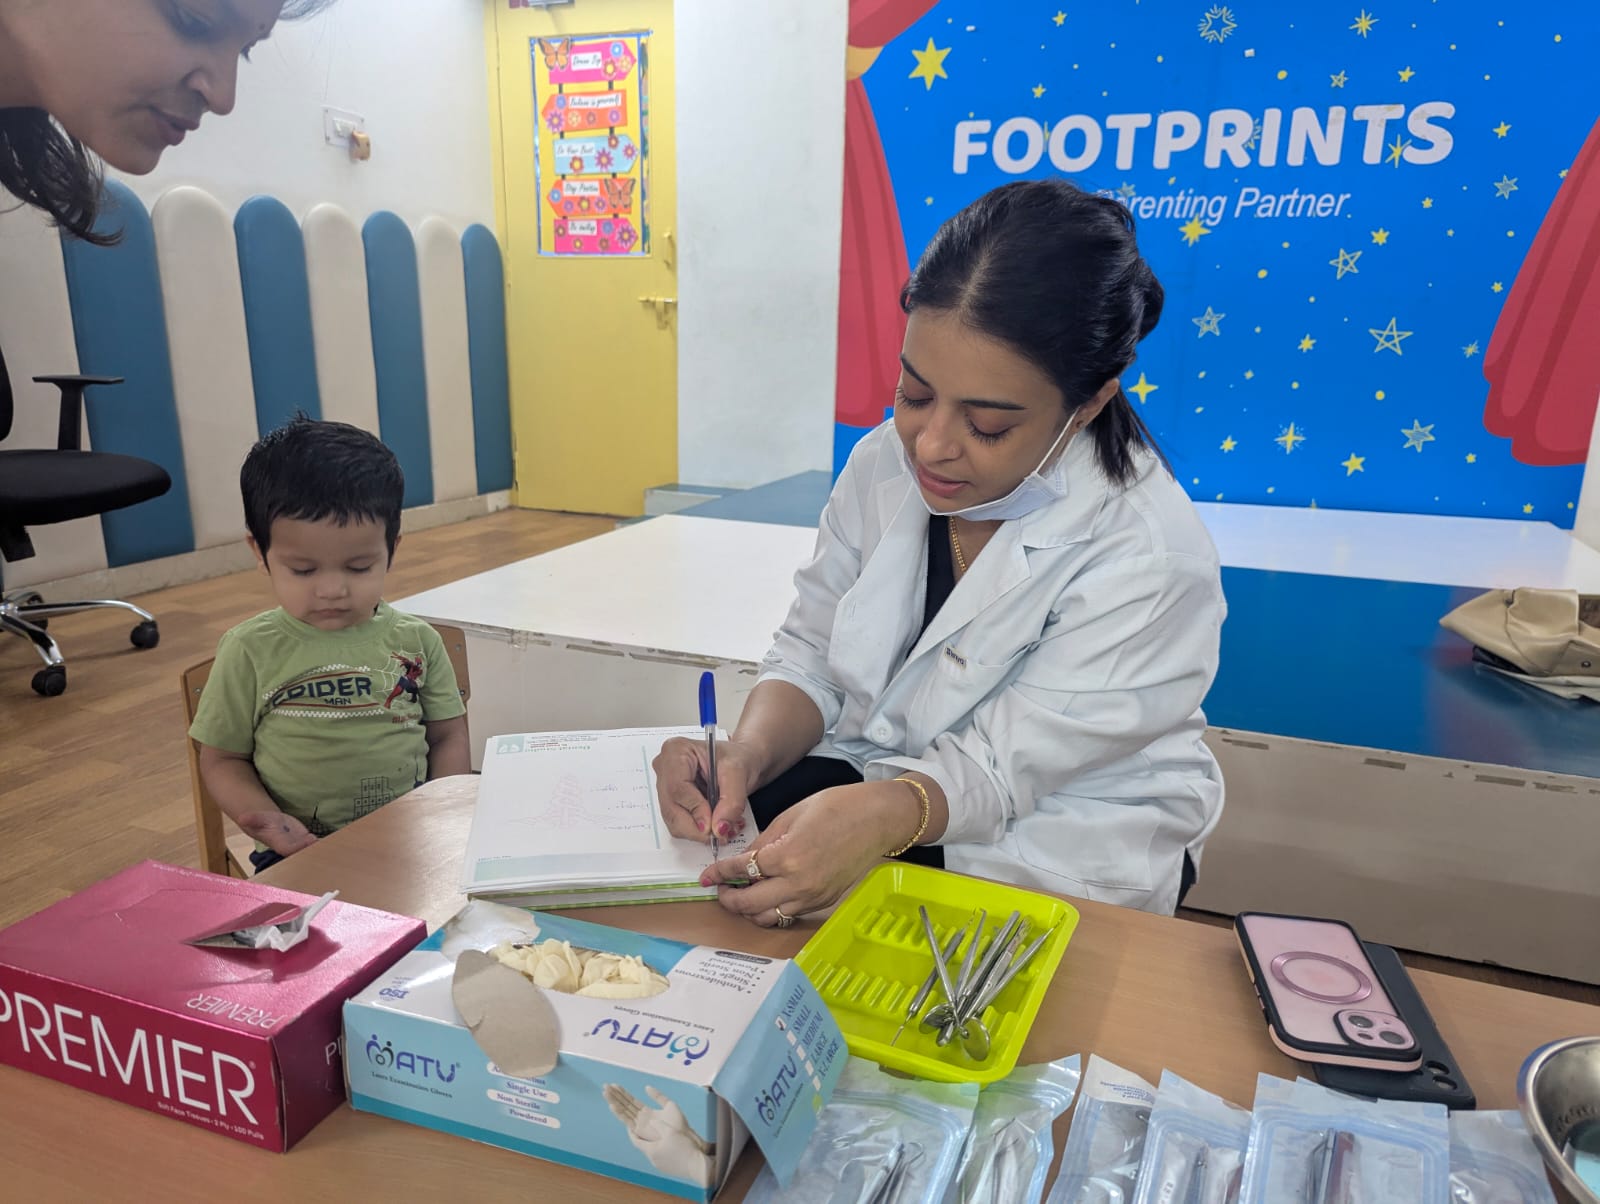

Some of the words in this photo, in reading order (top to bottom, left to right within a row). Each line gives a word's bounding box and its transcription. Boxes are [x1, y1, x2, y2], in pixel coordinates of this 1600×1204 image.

[953, 101, 1456, 174] FOOTPRINTS
[324, 697, 352, 705] MAN
[186, 993, 288, 1029] PREMIER
[793, 1004, 811, 1033] SMALL
[810, 1031, 828, 1065] LARGE
[505, 1080, 530, 1094] Single
[532, 1088, 547, 1098] Use
